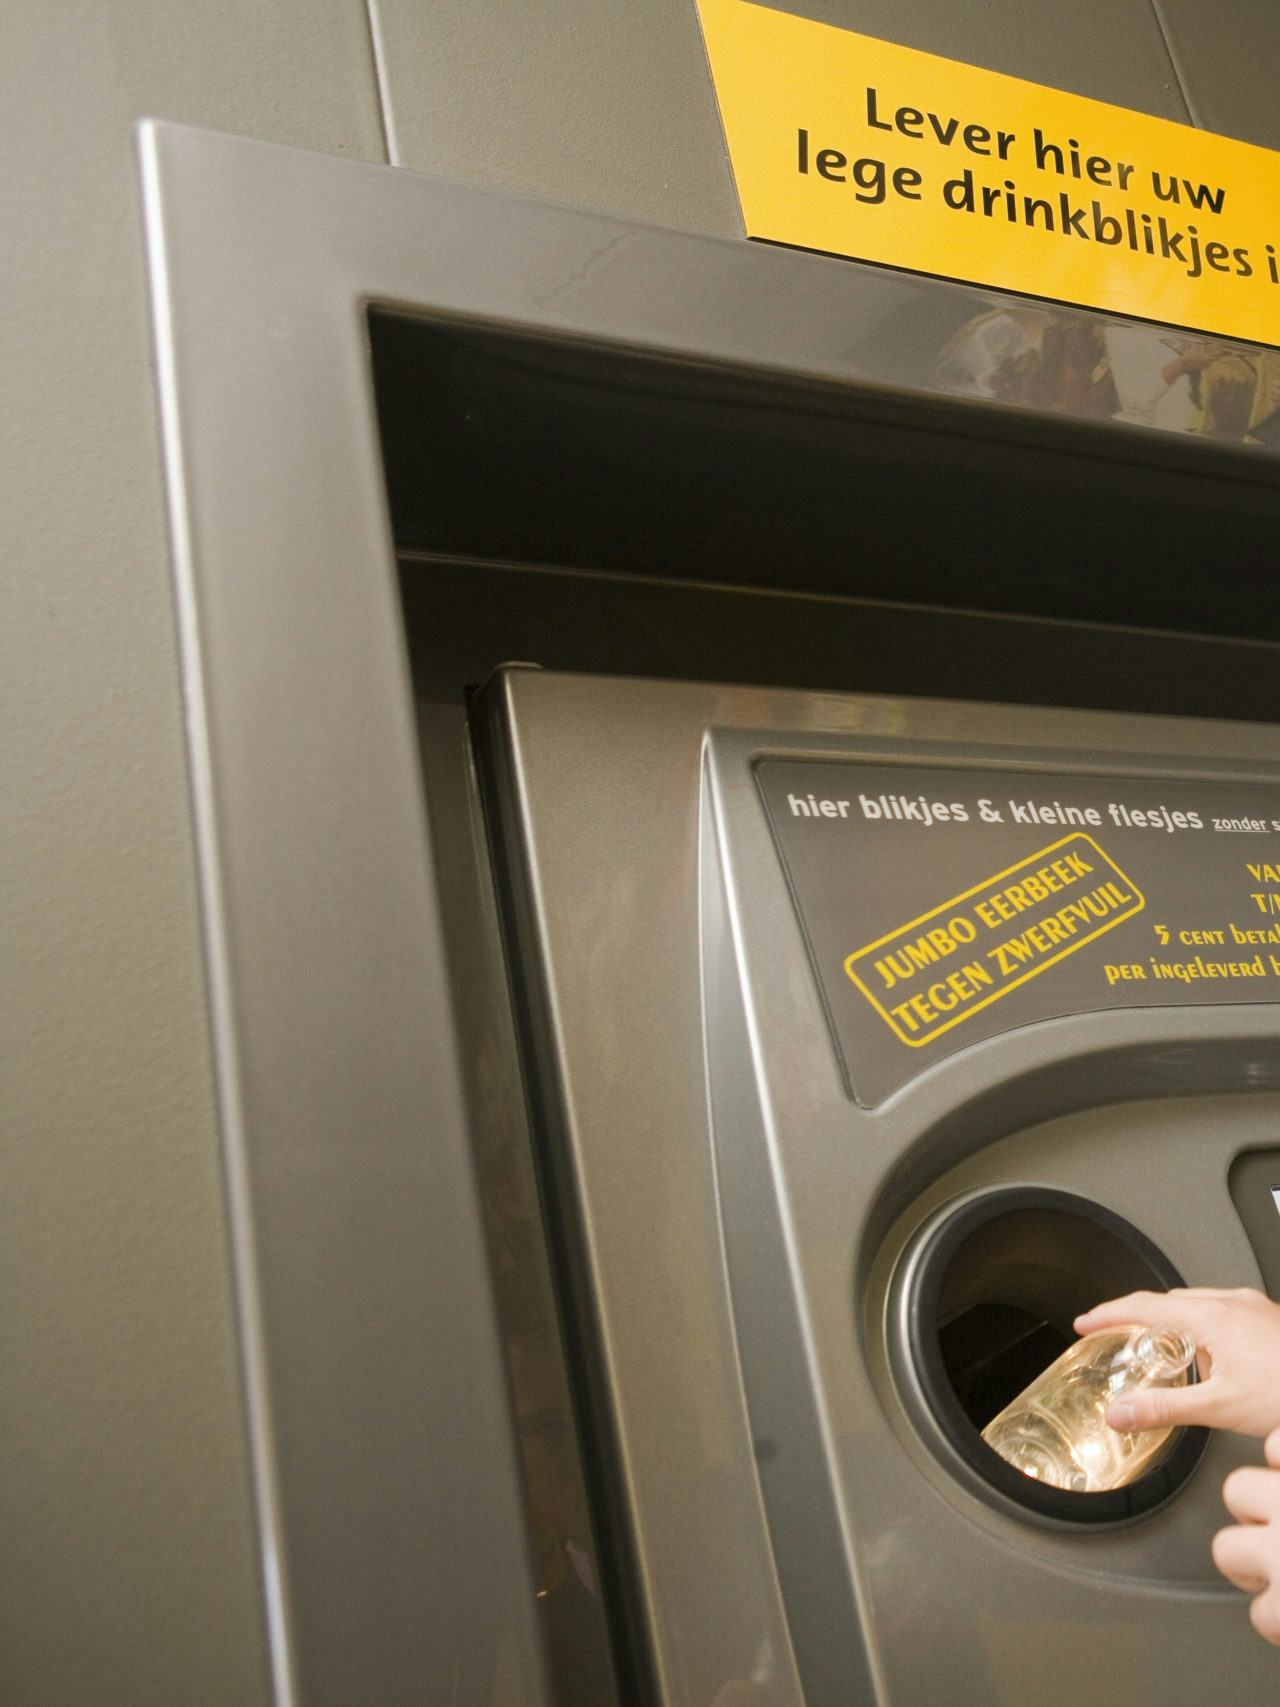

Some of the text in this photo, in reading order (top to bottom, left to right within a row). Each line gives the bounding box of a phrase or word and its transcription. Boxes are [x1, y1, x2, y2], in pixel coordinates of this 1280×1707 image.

[798, 130, 922, 204] lege
[943, 170, 1252, 278] drinkblikjes
[865, 88, 1226, 215] Lever hier uw
[787, 794, 850, 818] hier
[858, 794, 969, 826] blikjes
[978, 800, 1004, 823] &
[1009, 800, 1102, 826] kleine
[1108, 803, 1204, 833] flesjes
[1212, 817, 1270, 833] zonder
[873, 850, 1095, 989] JUMBO EERBEEK
[890, 881, 1133, 1033] TEGEN ZWERFVUIL
[1153, 925, 1170, 946] 5
